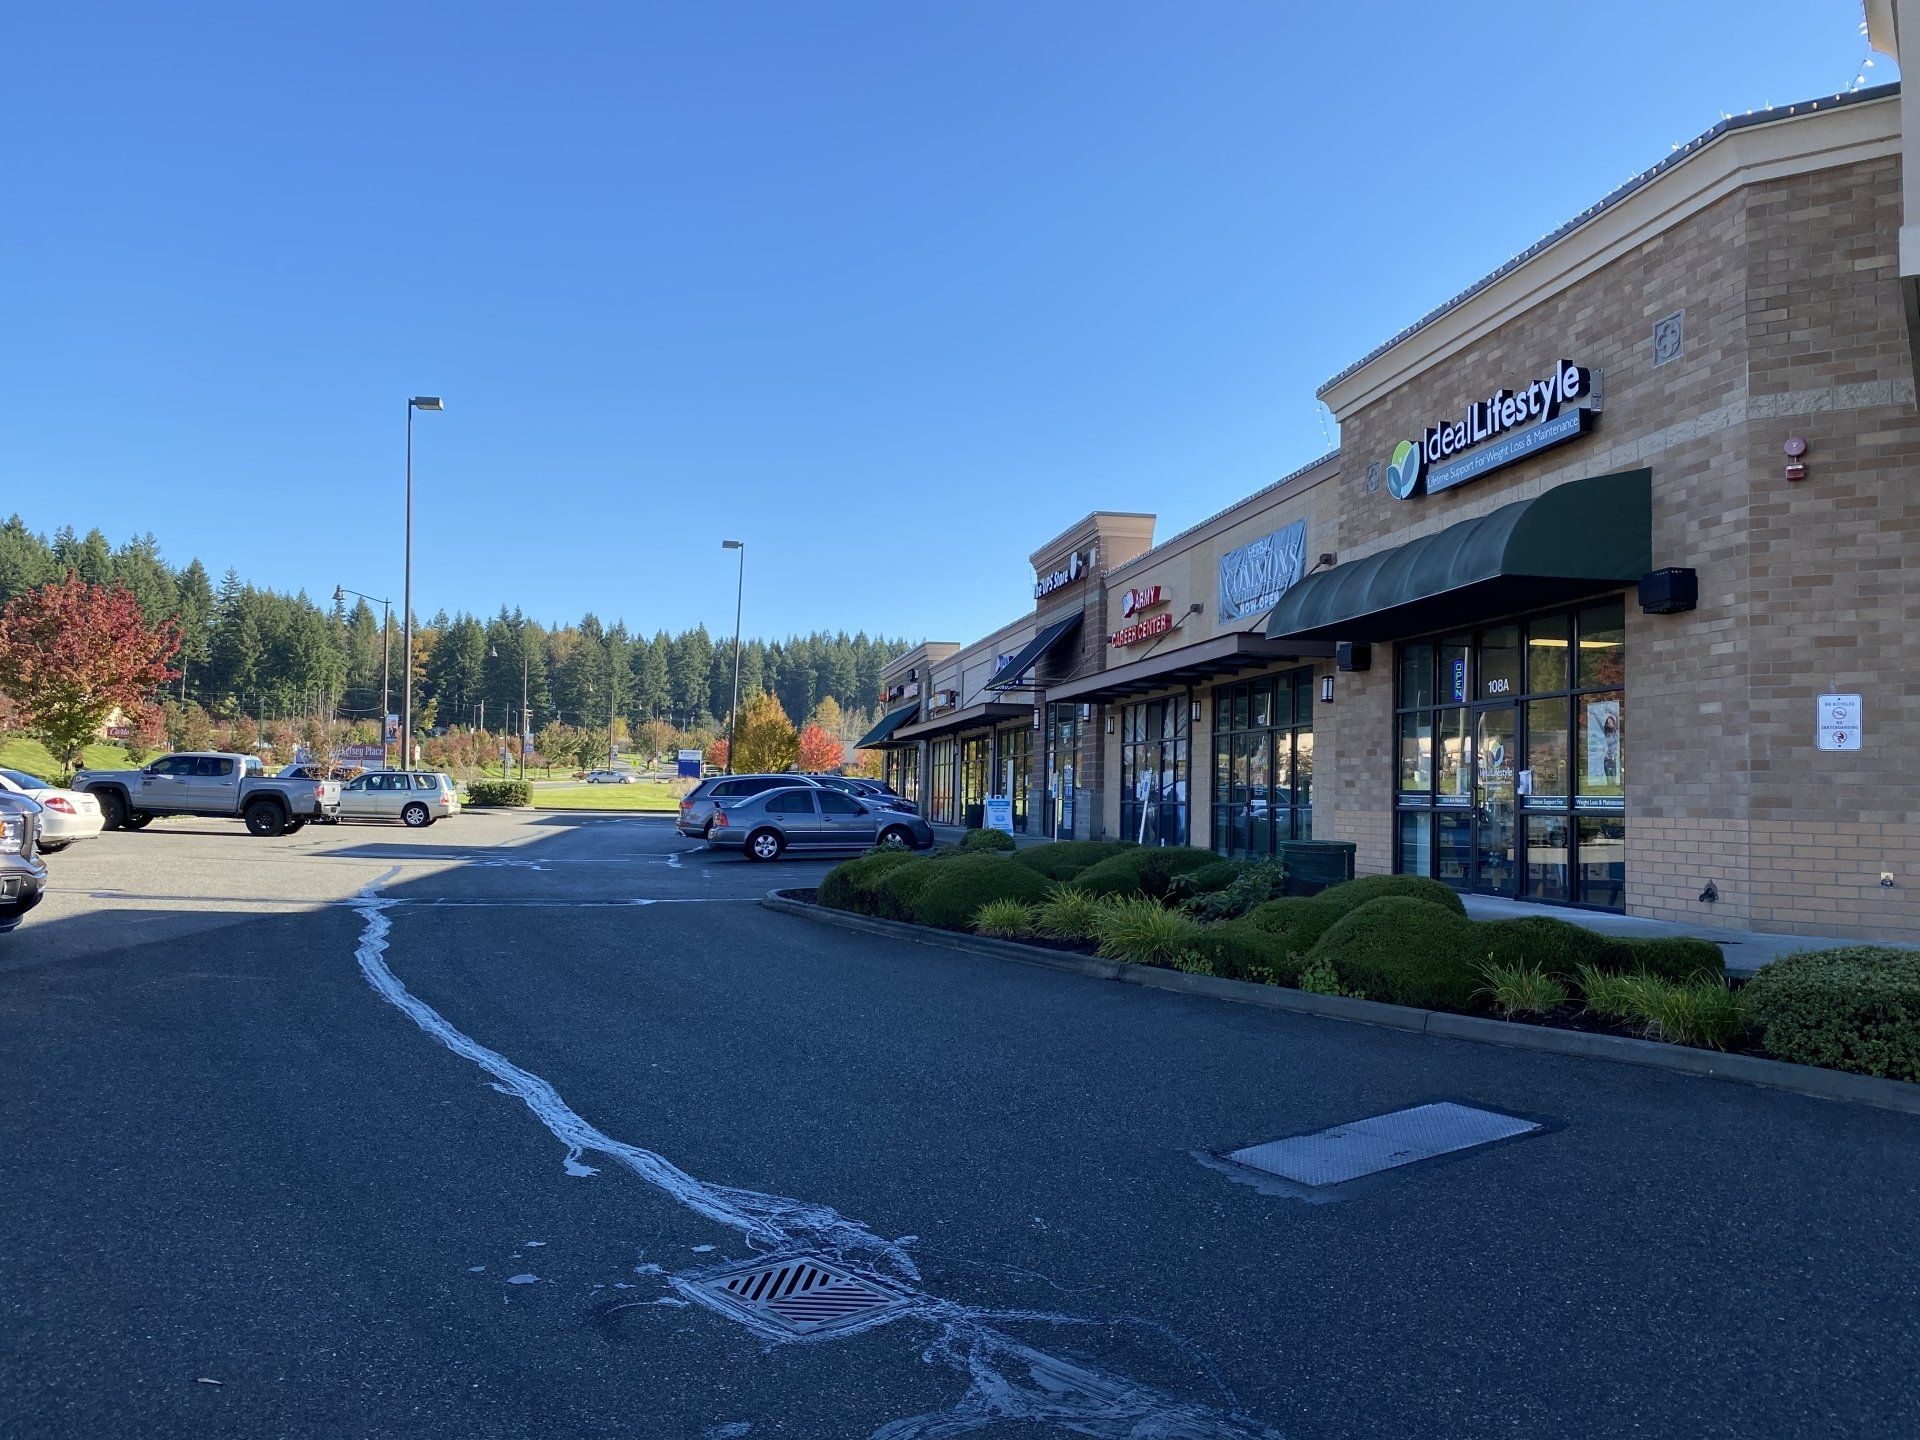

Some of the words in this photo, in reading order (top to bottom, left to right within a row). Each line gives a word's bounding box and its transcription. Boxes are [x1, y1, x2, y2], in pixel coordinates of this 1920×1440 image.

[1427, 473, 1450, 489] Lifetime
[1450, 461, 1476, 479] Support
[1474, 455, 1487, 469] For
[1485, 446, 1509, 462] Weight
[1510, 439, 1525, 453] Loss
[1526, 434, 1533, 446] &
[1533, 417, 1579, 444] Maintenance
[1226, 544, 1298, 598] COMMONS
[1134, 587, 1155, 610] ARMY
[1240, 599, 1258, 616] NOW
[1111, 626, 1137, 649] CAREER
[1138, 614, 1167, 639] CENTER
[1488, 678, 1510, 693] 108A
[365, 745, 384, 756] Place
